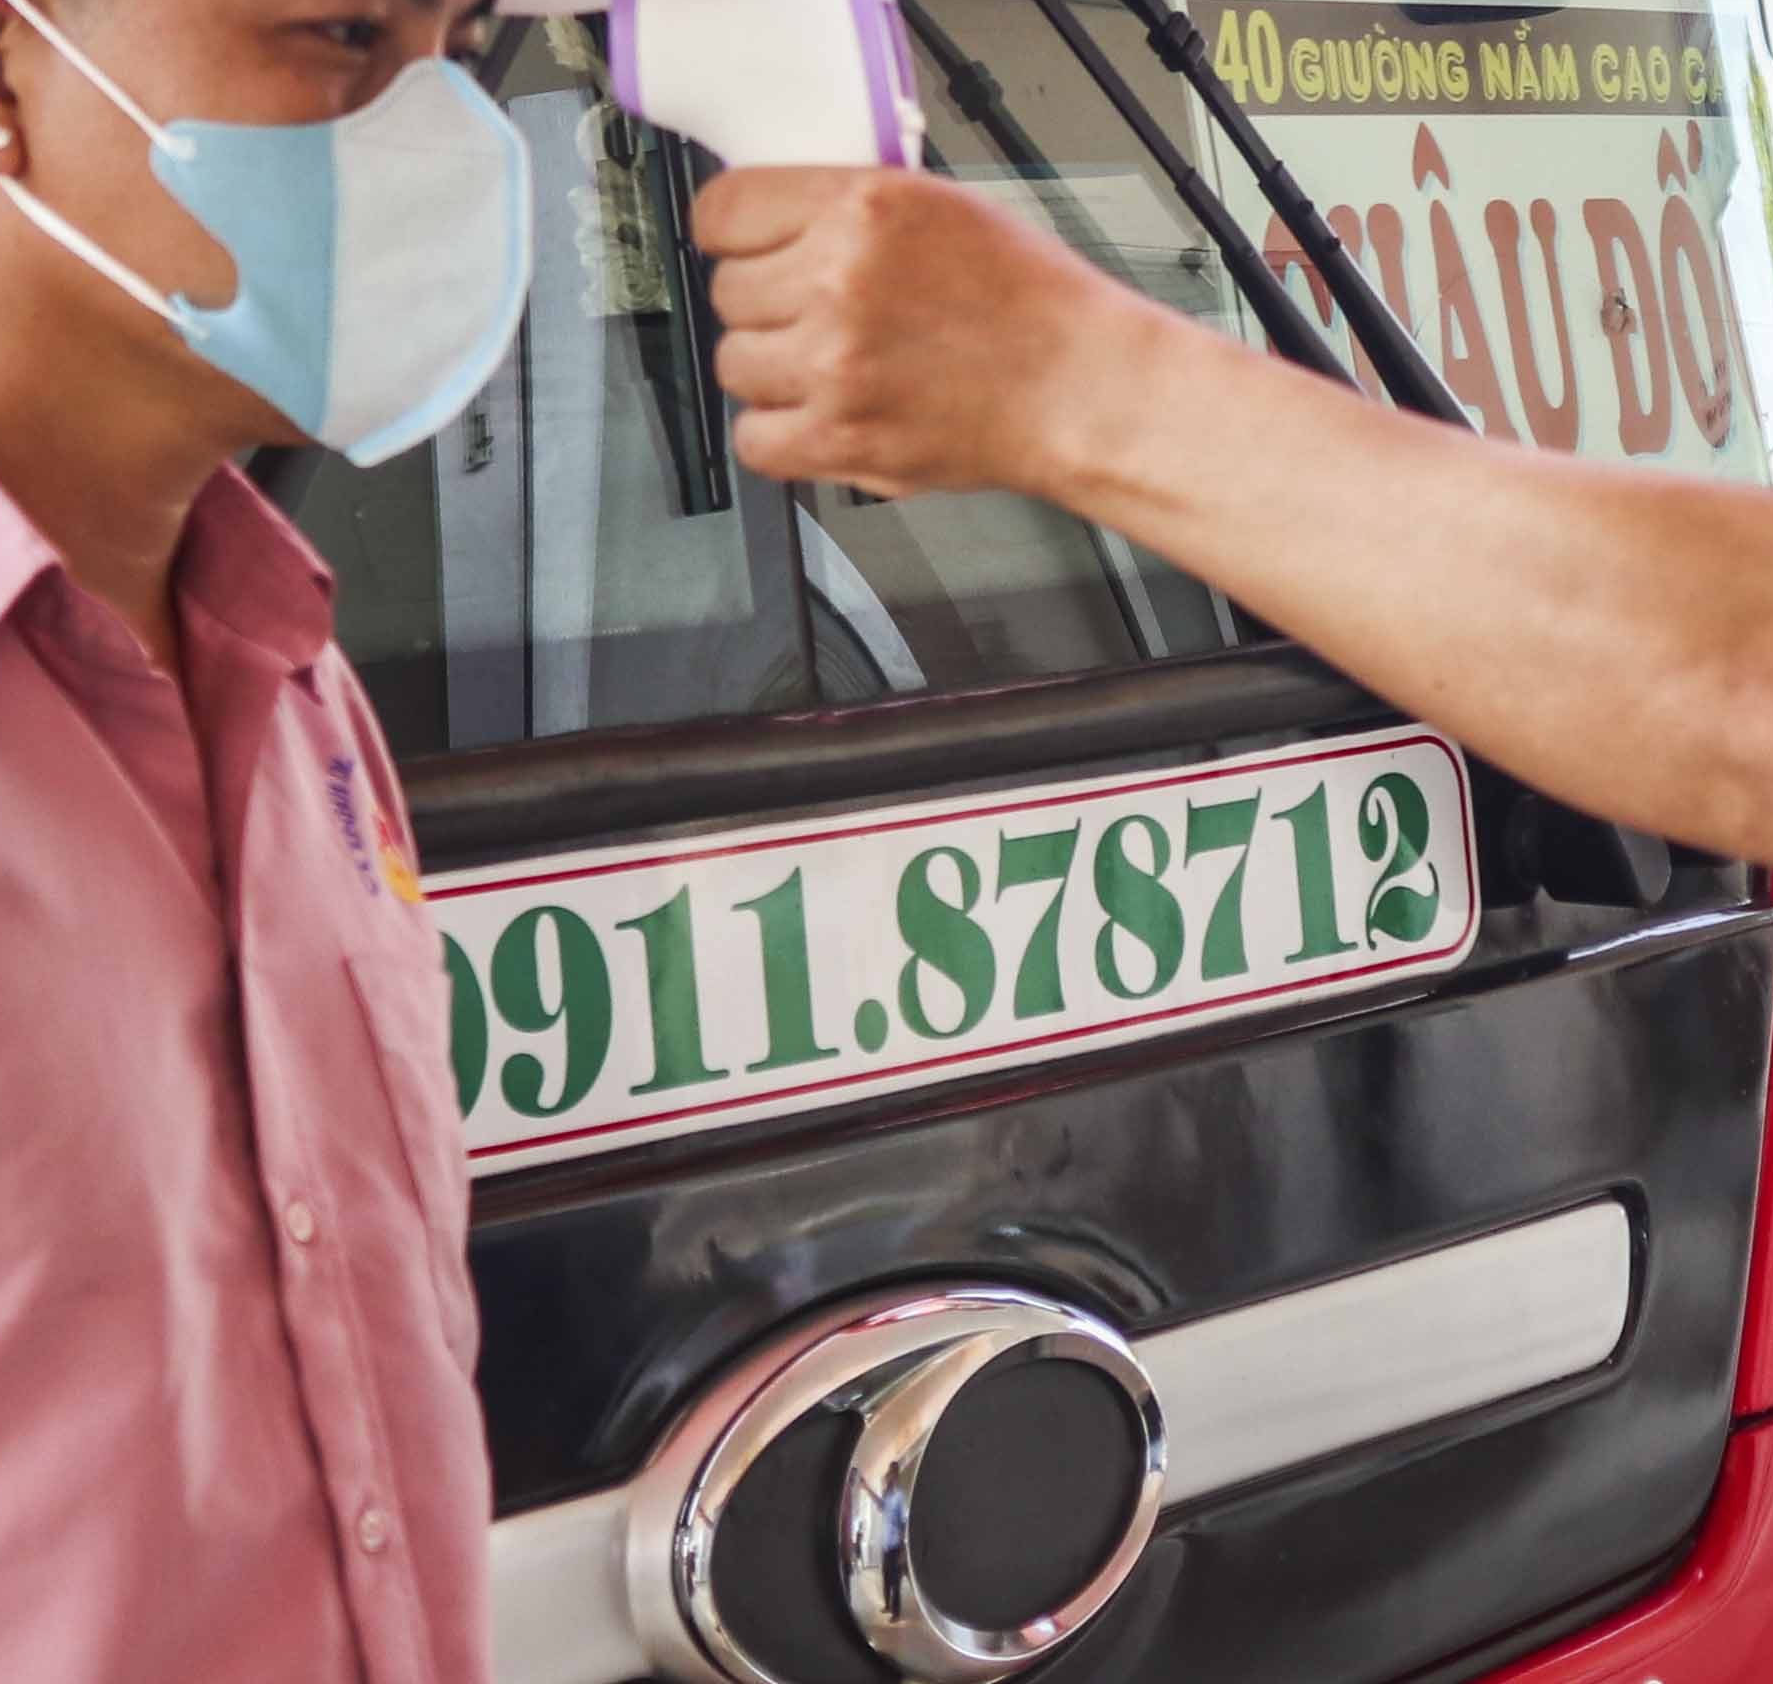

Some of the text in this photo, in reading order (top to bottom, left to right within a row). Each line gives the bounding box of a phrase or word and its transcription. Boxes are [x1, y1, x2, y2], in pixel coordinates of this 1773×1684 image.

[1213, 9, 1284, 105] 40
[1288, 22, 1471, 104] GIƯỜNG
[1478, 20, 1581, 103] NẰM
[1590, 43, 1672, 105] CAO
[1582, 119, 1733, 455] ĐỐ
